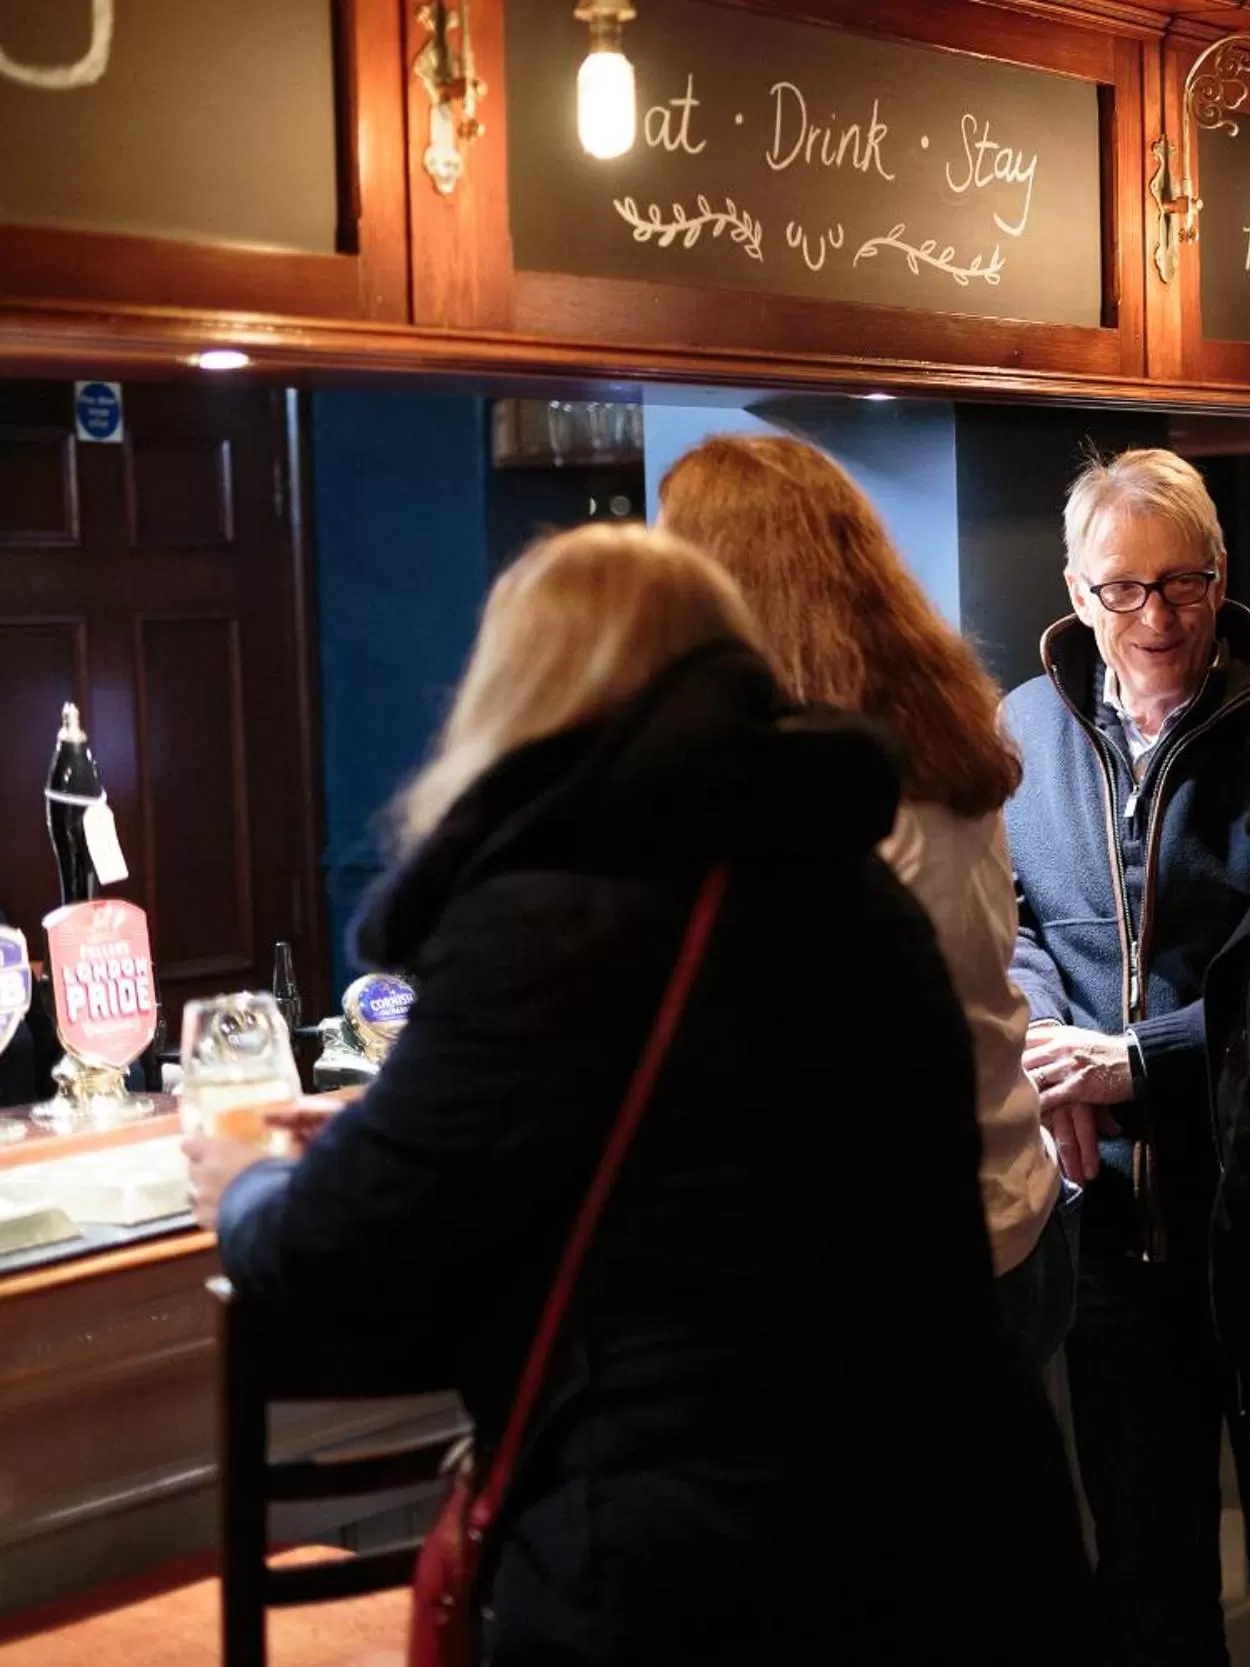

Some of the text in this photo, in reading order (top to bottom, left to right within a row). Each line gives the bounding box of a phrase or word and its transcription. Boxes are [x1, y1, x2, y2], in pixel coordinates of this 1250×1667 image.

[645, 73, 1038, 236] at Drink Stay
[63, 957, 150, 984] LONDON
[66, 977, 152, 1024] PRIDE
